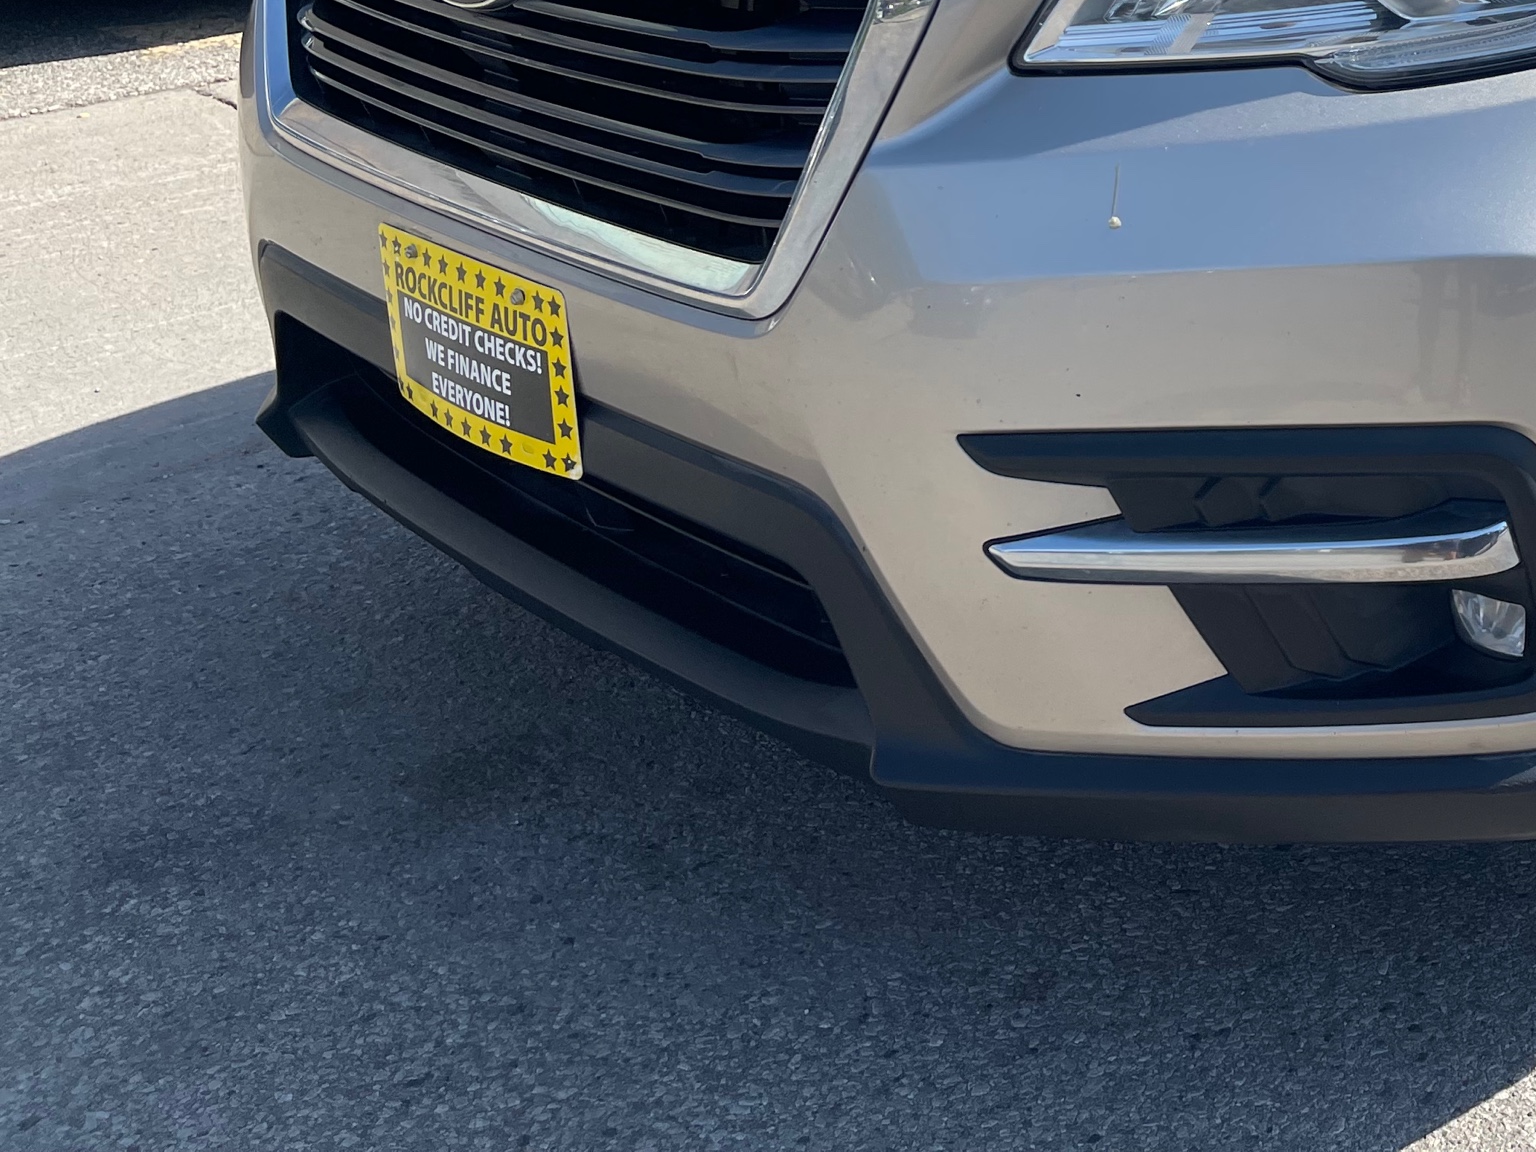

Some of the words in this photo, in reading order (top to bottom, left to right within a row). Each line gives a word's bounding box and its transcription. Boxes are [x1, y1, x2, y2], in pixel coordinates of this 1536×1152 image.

[395, 261, 485, 324] ROCKCLIFF
[490, 302, 547, 347] AUTO
[404, 297, 422, 324] NO
[425, 308, 471, 346] CREDIT
[474, 330, 542, 375] CHECKS!
[425, 337, 445, 367] WE
[447, 348, 511, 396] FINANCE
[431, 372, 511, 427] EVERYONE!
